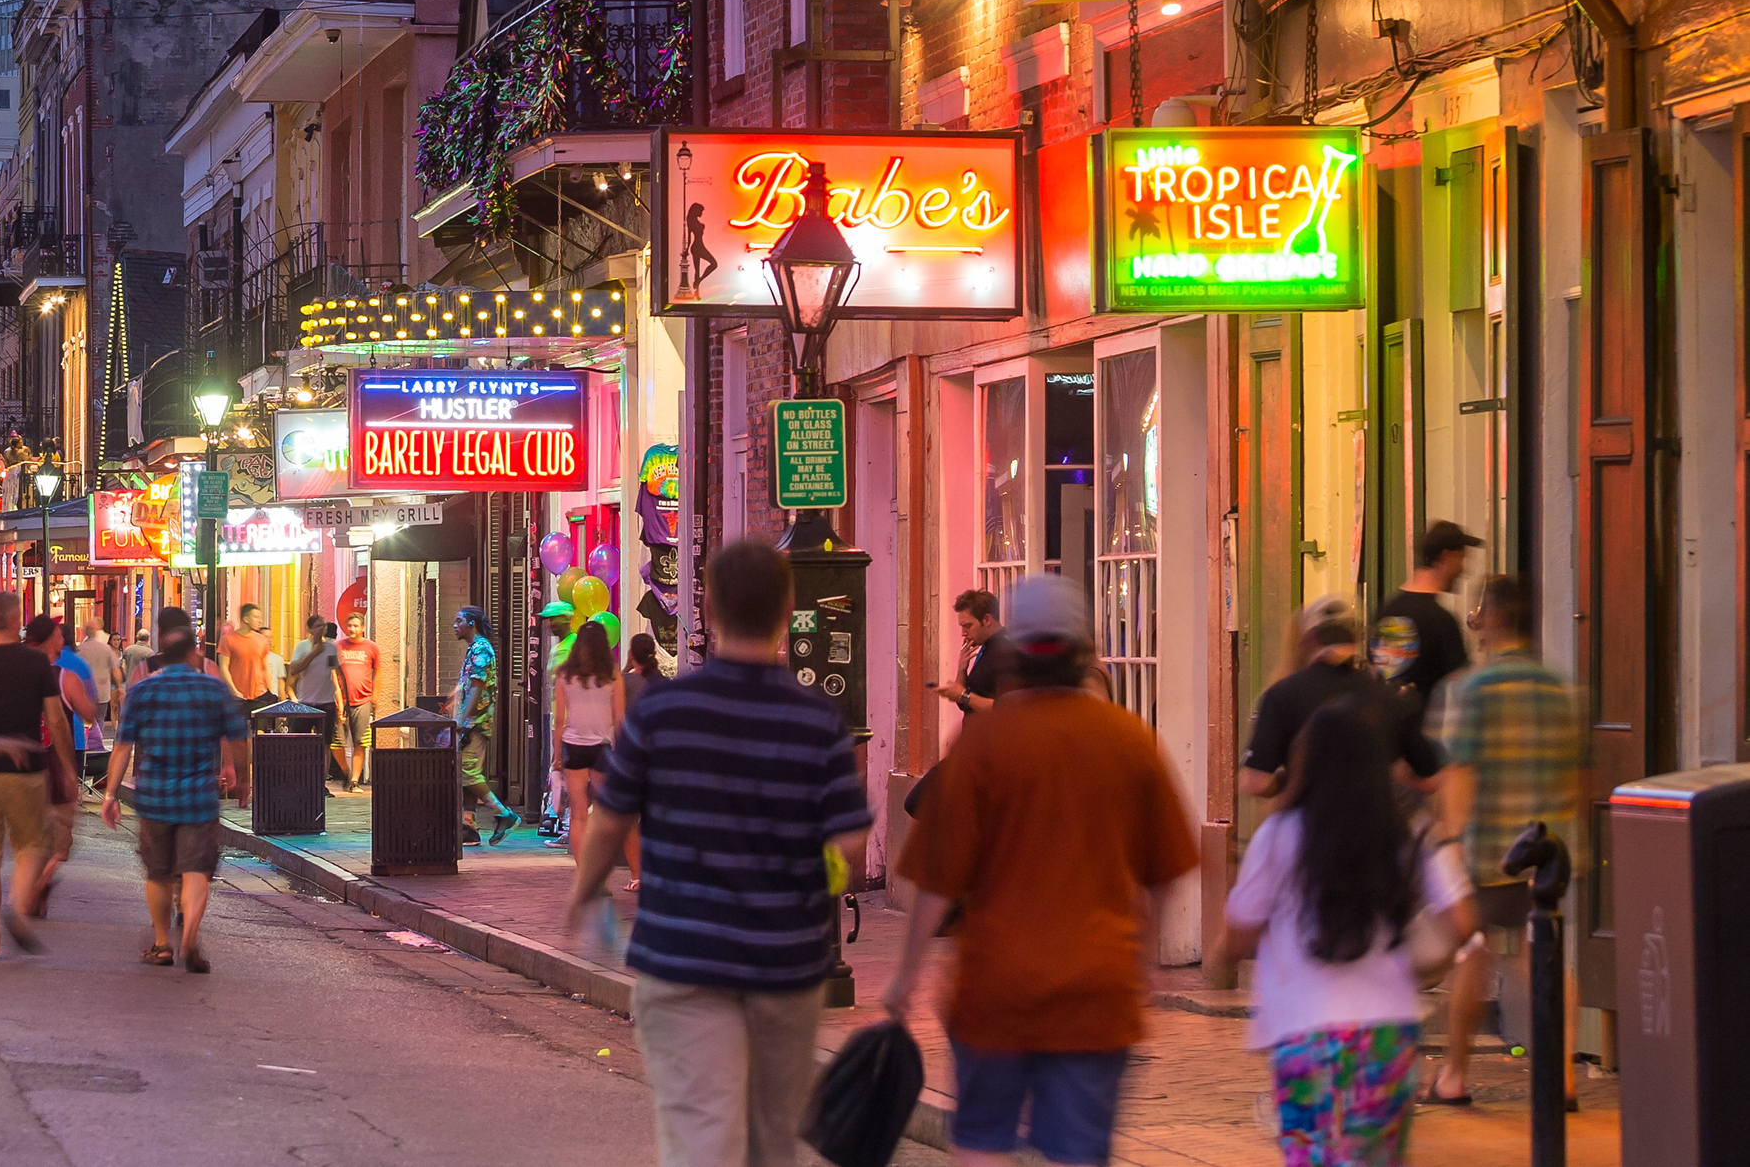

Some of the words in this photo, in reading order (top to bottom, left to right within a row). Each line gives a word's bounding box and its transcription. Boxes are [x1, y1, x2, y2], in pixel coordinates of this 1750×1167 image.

[1193, 204, 1282, 240] ISLE
[1133, 254, 1208, 279] HAND
[1215, 253, 1338, 281] GRENADE
[1120, 285, 1148, 296] NEW
[1151, 284, 1205, 296] ORLEANS
[1207, 284, 1239, 295] MOST
[1242, 284, 1307, 295] POWERFUL
[1309, 283, 1347, 294] DRINK
[402, 381, 457, 393] LARRY
[469, 381, 540, 395] FLYNT'S
[783, 411, 795, 419] NO
[799, 410, 837, 420] BOTTLES
[788, 421, 800, 429] OR
[803, 420, 832, 429] GLASS
[790, 430, 831, 440] ALLOWED
[786, 441, 799, 450] ON
[802, 440, 835, 449] STREET
[365, 430, 446, 475] BARELY
[452, 430, 518, 476] LEGAL
[523, 430, 575, 476] CLUB
[805, 456, 832, 464] DRINKS
[797, 465, 813, 473] MAY
[802, 473, 831, 481] PLASTIC
[789, 482, 834, 490] CONTAINERS
[306, 510, 353, 526] FRESH
[361, 508, 390, 524] MEX
[397, 506, 440, 522] GRILL
